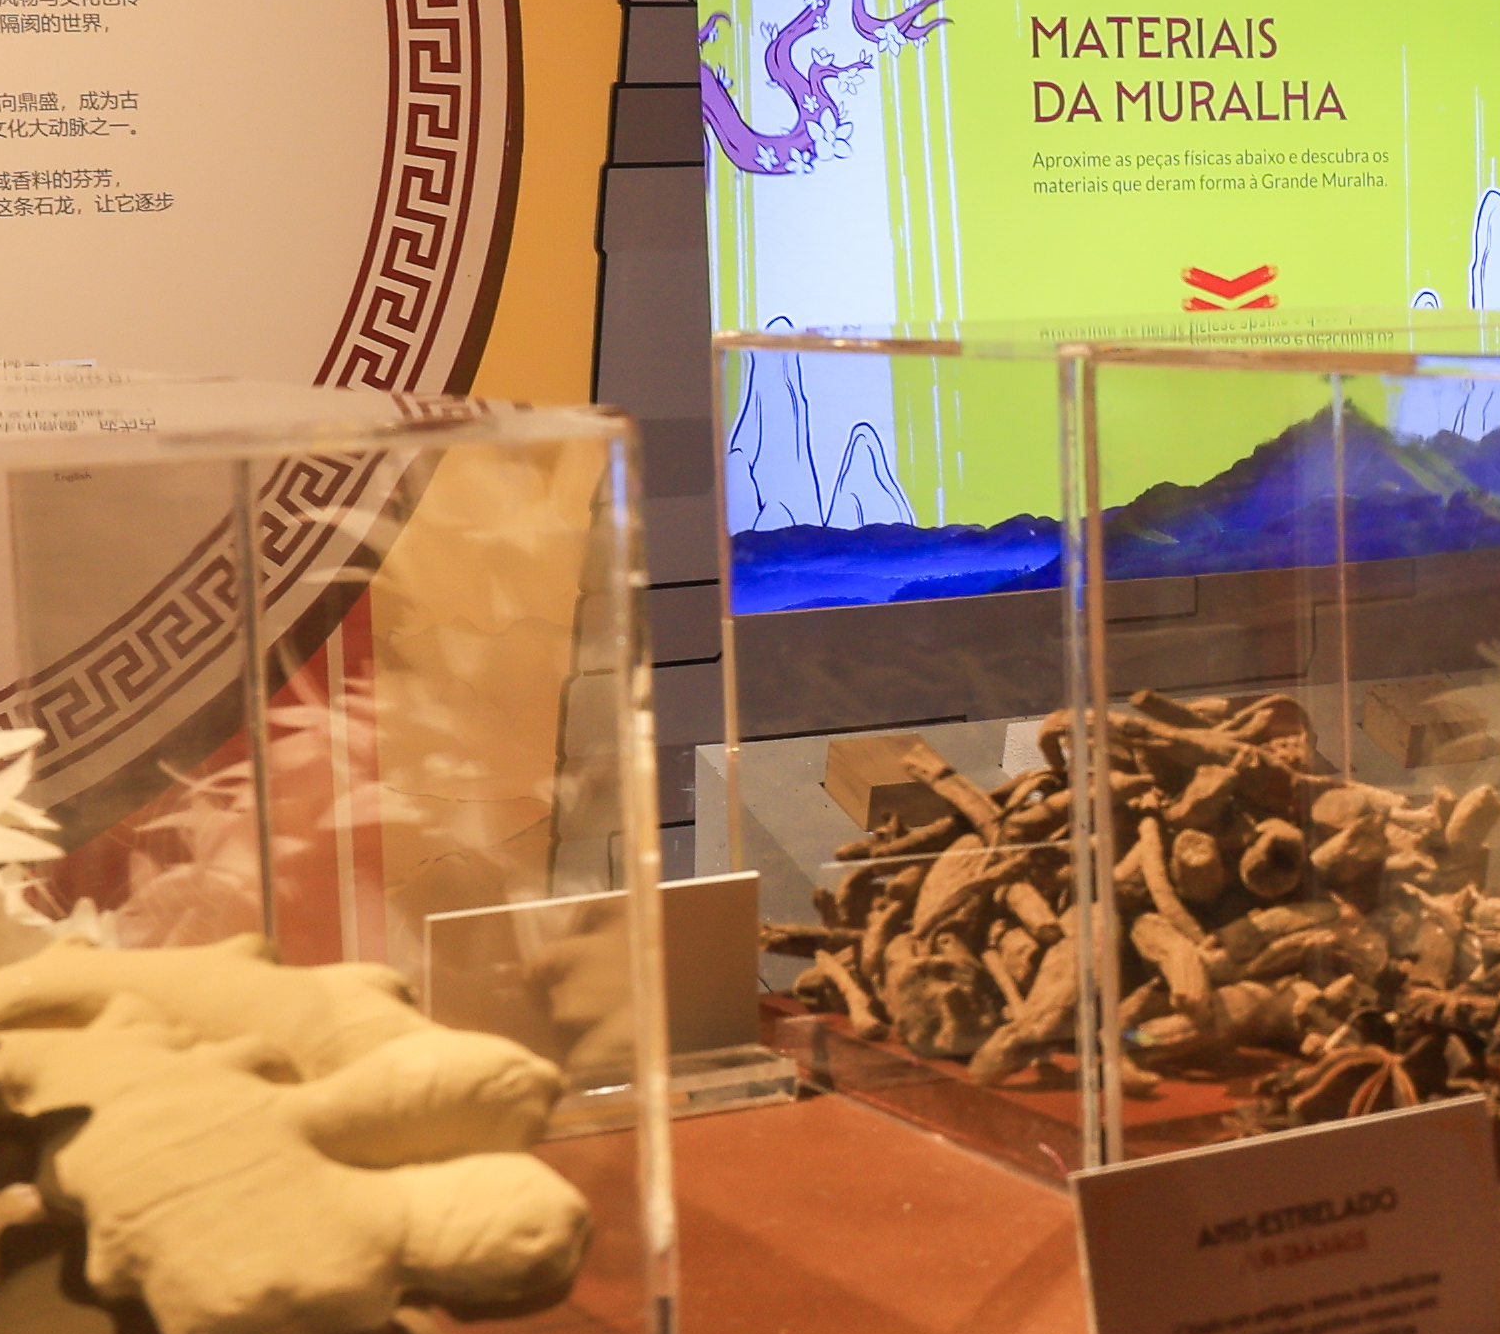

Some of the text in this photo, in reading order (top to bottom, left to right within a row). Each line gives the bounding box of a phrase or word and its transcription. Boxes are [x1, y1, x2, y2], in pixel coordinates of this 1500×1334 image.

[1031, 17, 1277, 58] MATERIAIS
[1033, 81, 1347, 122] DA MURALHA
[1033, 148, 1388, 171] Aproxime as peças físicas abaixo e descubra os
[1034, 172, 1387, 195] materiais que deram forma à Grande Muralha.
